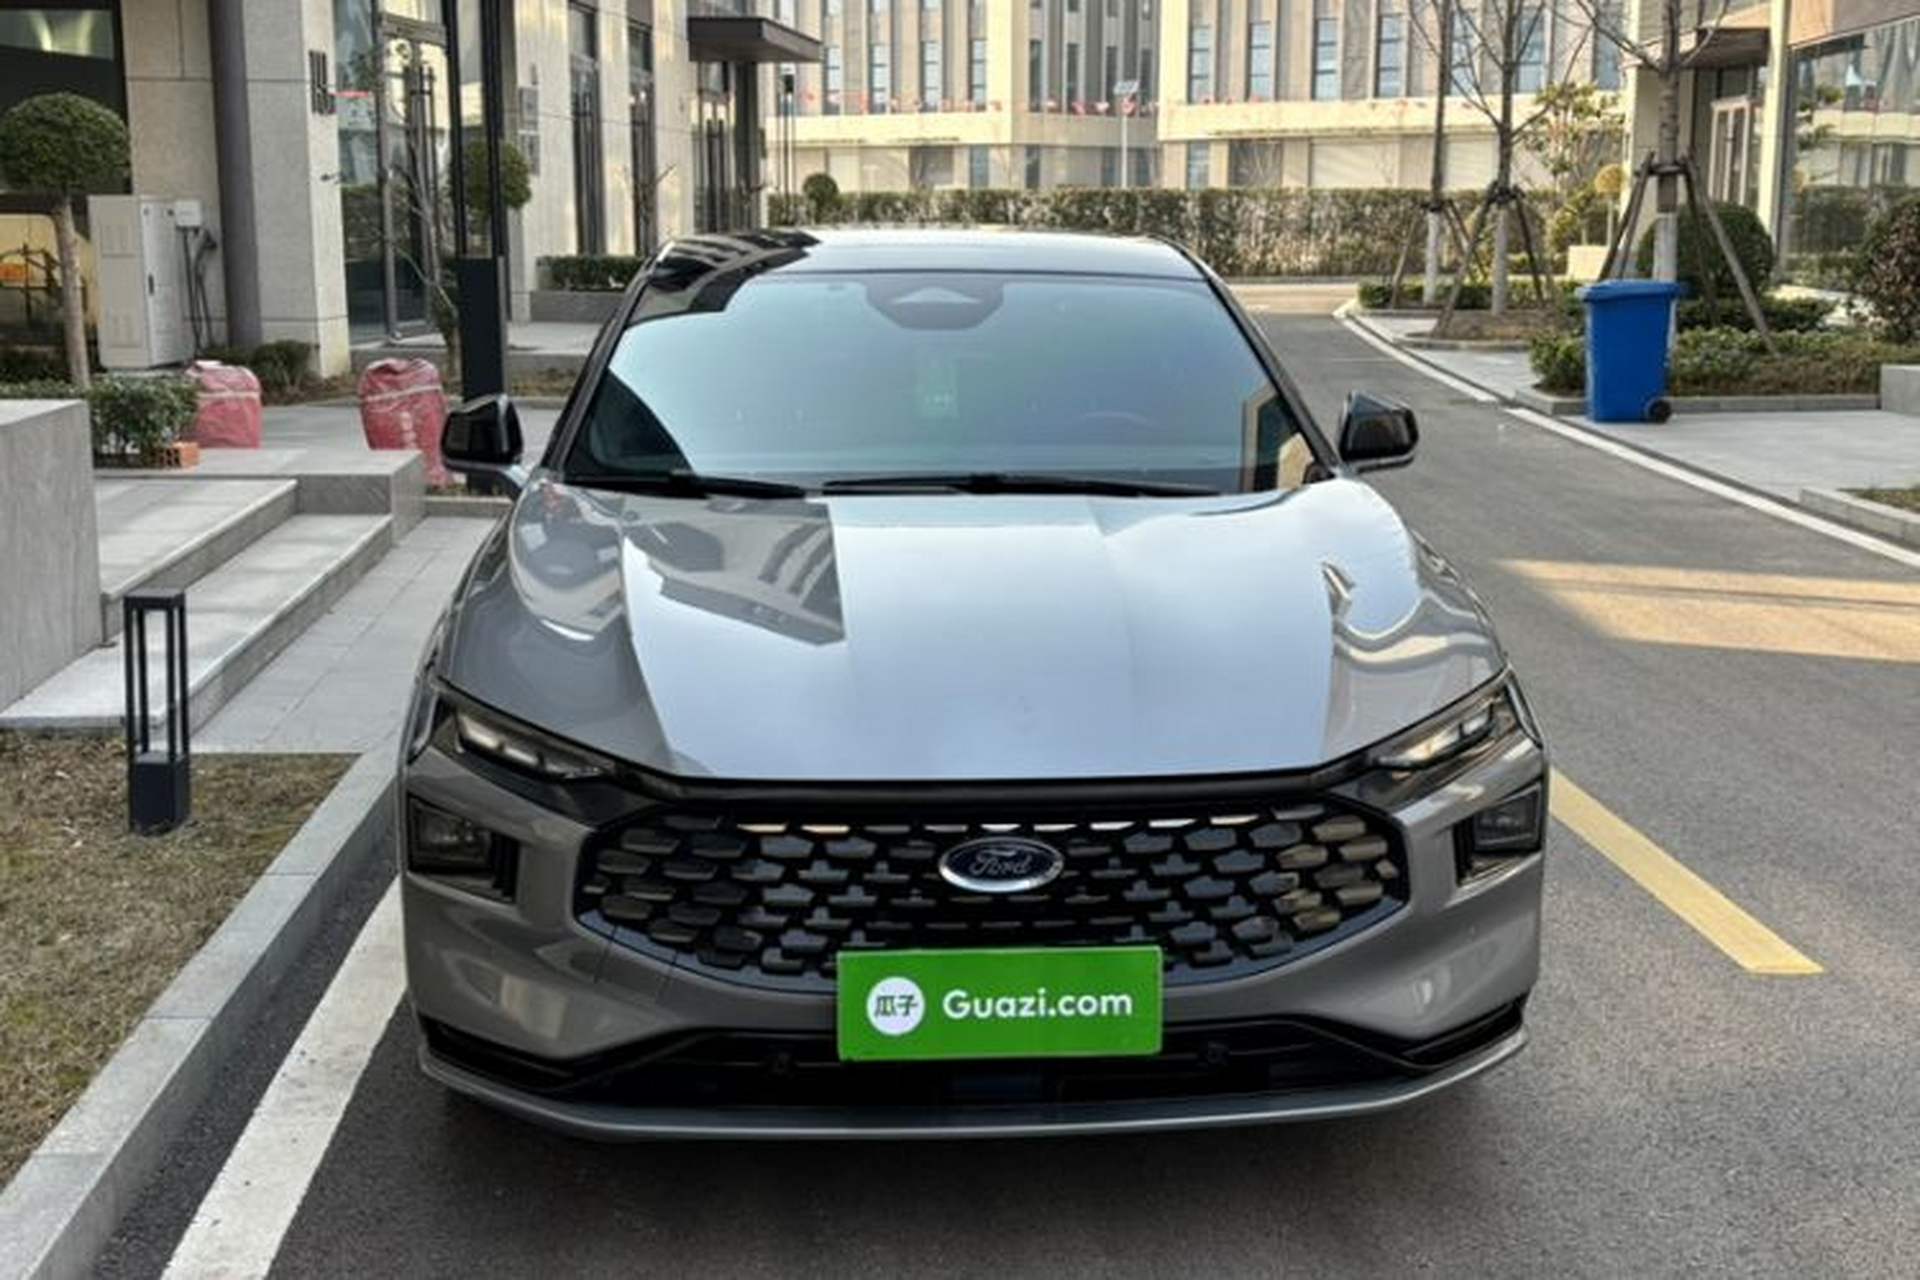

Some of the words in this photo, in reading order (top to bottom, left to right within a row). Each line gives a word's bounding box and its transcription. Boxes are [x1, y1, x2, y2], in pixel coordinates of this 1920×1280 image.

[968, 849, 1033, 876] Ford
[874, 994, 918, 1018] 瓜子
[942, 987, 1133, 1019] Guazi.com
